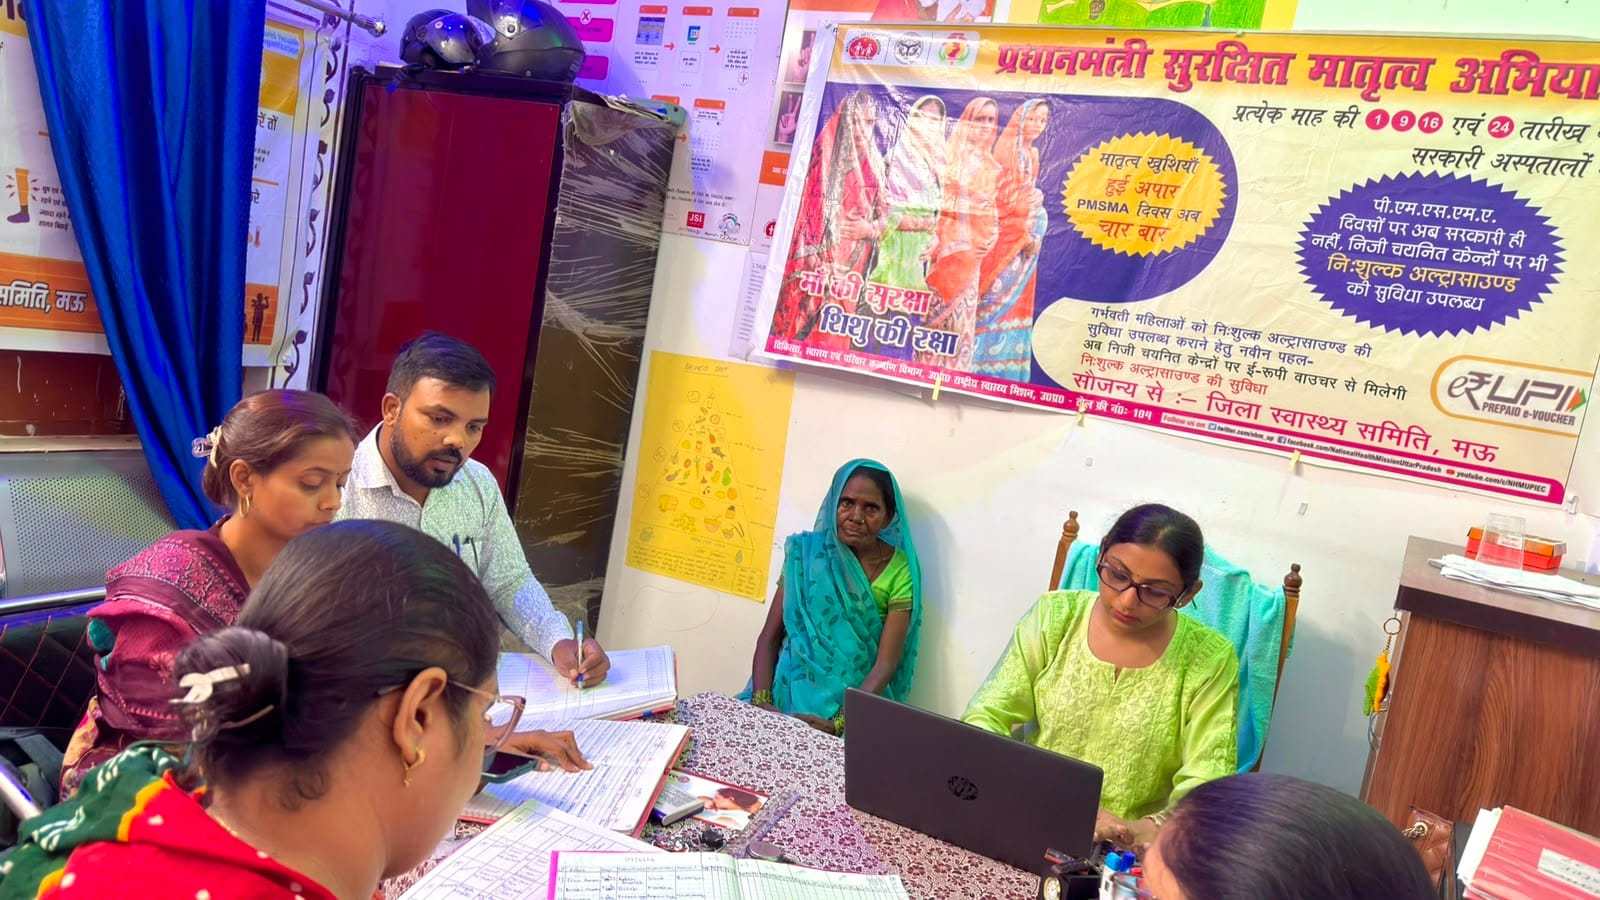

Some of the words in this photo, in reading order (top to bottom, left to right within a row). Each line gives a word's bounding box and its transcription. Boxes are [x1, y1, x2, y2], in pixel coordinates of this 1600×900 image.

[996, 37, 1153, 78] प्रधानमंत्री
[1164, 40, 1297, 93] सुरक्षित
[1308, 52, 1436, 102] मातृत्व
[1450, 49, 1600, 100] अभिया
[1232, 101, 1287, 125] प्रत्येक
[1290, 108, 1326, 128] माह
[1334, 105, 1360, 129] की
[1374, 114, 1382, 125] 1
[1400, 116, 1409, 128] 9
[1422, 117, 1439, 129] 16
[1452, 114, 1485, 138] एवं
[1491, 121, 1510, 134] 24
[1519, 116, 1591, 144] तारीख
[1099, 152, 1141, 170] मातृत्व
[1146, 155, 1199, 176] खुशियाँ
[1411, 146, 1484, 170] सरकारी
[1491, 152, 1594, 178] अस्पतालों
[1105, 176, 1130, 197] हुई
[1134, 182, 1181, 198] अपार
[689, 213, 703, 223] JSI
[1076, 198, 1129, 214] PMSMA
[1136, 201, 1172, 221] दिवस
[1177, 209, 1202, 224] अब
[1373, 195, 1497, 225] पी.एम.एस.एम.ए.
[1099, 221, 1130, 238] चार
[1137, 226, 1170, 243] बार
[1338, 213, 1386, 235] दिवसों
[1388, 220, 1409, 236] पर
[1412, 224, 1439, 241] अब
[1444, 225, 1504, 248] सरकारी
[1508, 228, 1527, 249] ही
[1311, 232, 1344, 252] नहीं,
[1347, 234, 1388, 255] निजी
[1391, 240, 1448, 262] चयनित
[1452, 243, 1501, 268] केन्द्रों
[1503, 254, 1525, 270] पर
[1529, 252, 1549, 272] भी
[799, 266, 825, 298] माँ
[830, 272, 864, 302] की
[865, 282, 934, 315] सुरक्षा
[1346, 280, 1369, 298] की
[1374, 282, 1424, 305] सुविधा
[1426, 291, 1485, 312] उपलब्ध
[1409, 266, 1521, 293] अल्ट्रासाउण्ड
[56, 290, 88, 312] मऊ
[820, 304, 873, 346] शिशु
[875, 317, 912, 348] की
[913, 327, 961, 357] रक्षा
[1087, 322, 1123, 340] सुविधा
[1128, 331, 1170, 346] उपलब्ध
[1176, 334, 1208, 352] कराने
[1214, 340, 1234, 357] हेतु
[1239, 344, 1272, 361] नवीन
[1278, 350, 1314, 367] पहल-
[1091, 306, 1129, 323] गर्भवती
[1135, 312, 1187, 332] महिलाओं
[1191, 317, 1208, 334] को
[1267, 332, 1347, 355] अल्ट्रासाउण्ड
[1354, 342, 1373, 359] की
[843, 353, 866, 367] परिवार
[869, 359, 896, 372] कल्याण
[899, 363, 925, 378] विभाग,
[954, 375, 978, 388] राष्ट्रीय
[981, 381, 1007, 394] स्वास्थ्य
[1009, 385, 1036, 400] मिशन,
[1096, 400, 1108, 412] फ्री
[1133, 409, 1152, 420] 104
[1083, 338, 1103, 353] अब
[1107, 338, 1135, 357] निजी
[1141, 346, 1182, 365] चयनित
[1187, 348, 1219, 370] केन्द्रों
[1225, 358, 1241, 374] पर
[1247, 359, 1287, 382] ई-रूपी
[1294, 369, 1338, 389] वाउचर
[1344, 375, 1358, 392] से
[1363, 378, 1407, 401] मिलेगी
[1129, 360, 1201, 384] अल्ट्रासाउण्ड
[1207, 370, 1223, 388] की
[1229, 375, 1268, 397] सुविधा
[1072, 369, 1137, 399] सौजन्य
[1146, 381, 1164, 404] से
[1207, 389, 1263, 421] जिला
[1270, 406, 1349, 436] स्वास्थ्य
[1357, 420, 1441, 456] समिति,
[1452, 438, 1500, 464] मऊ
[1163, 414, 1186, 426] Follow
[1187, 419, 1195, 427] us
[1196, 421, 1206, 429] on
[1482, 402, 1521, 418] PREPAID
[1523, 409, 1576, 427] e-VOUCHER
[1287, 437, 1442, 473] facebook.com/NationalHealthMissionUttarPradesh
[1456, 470, 1547, 493] youtube.com/c/NHMUPIEC
